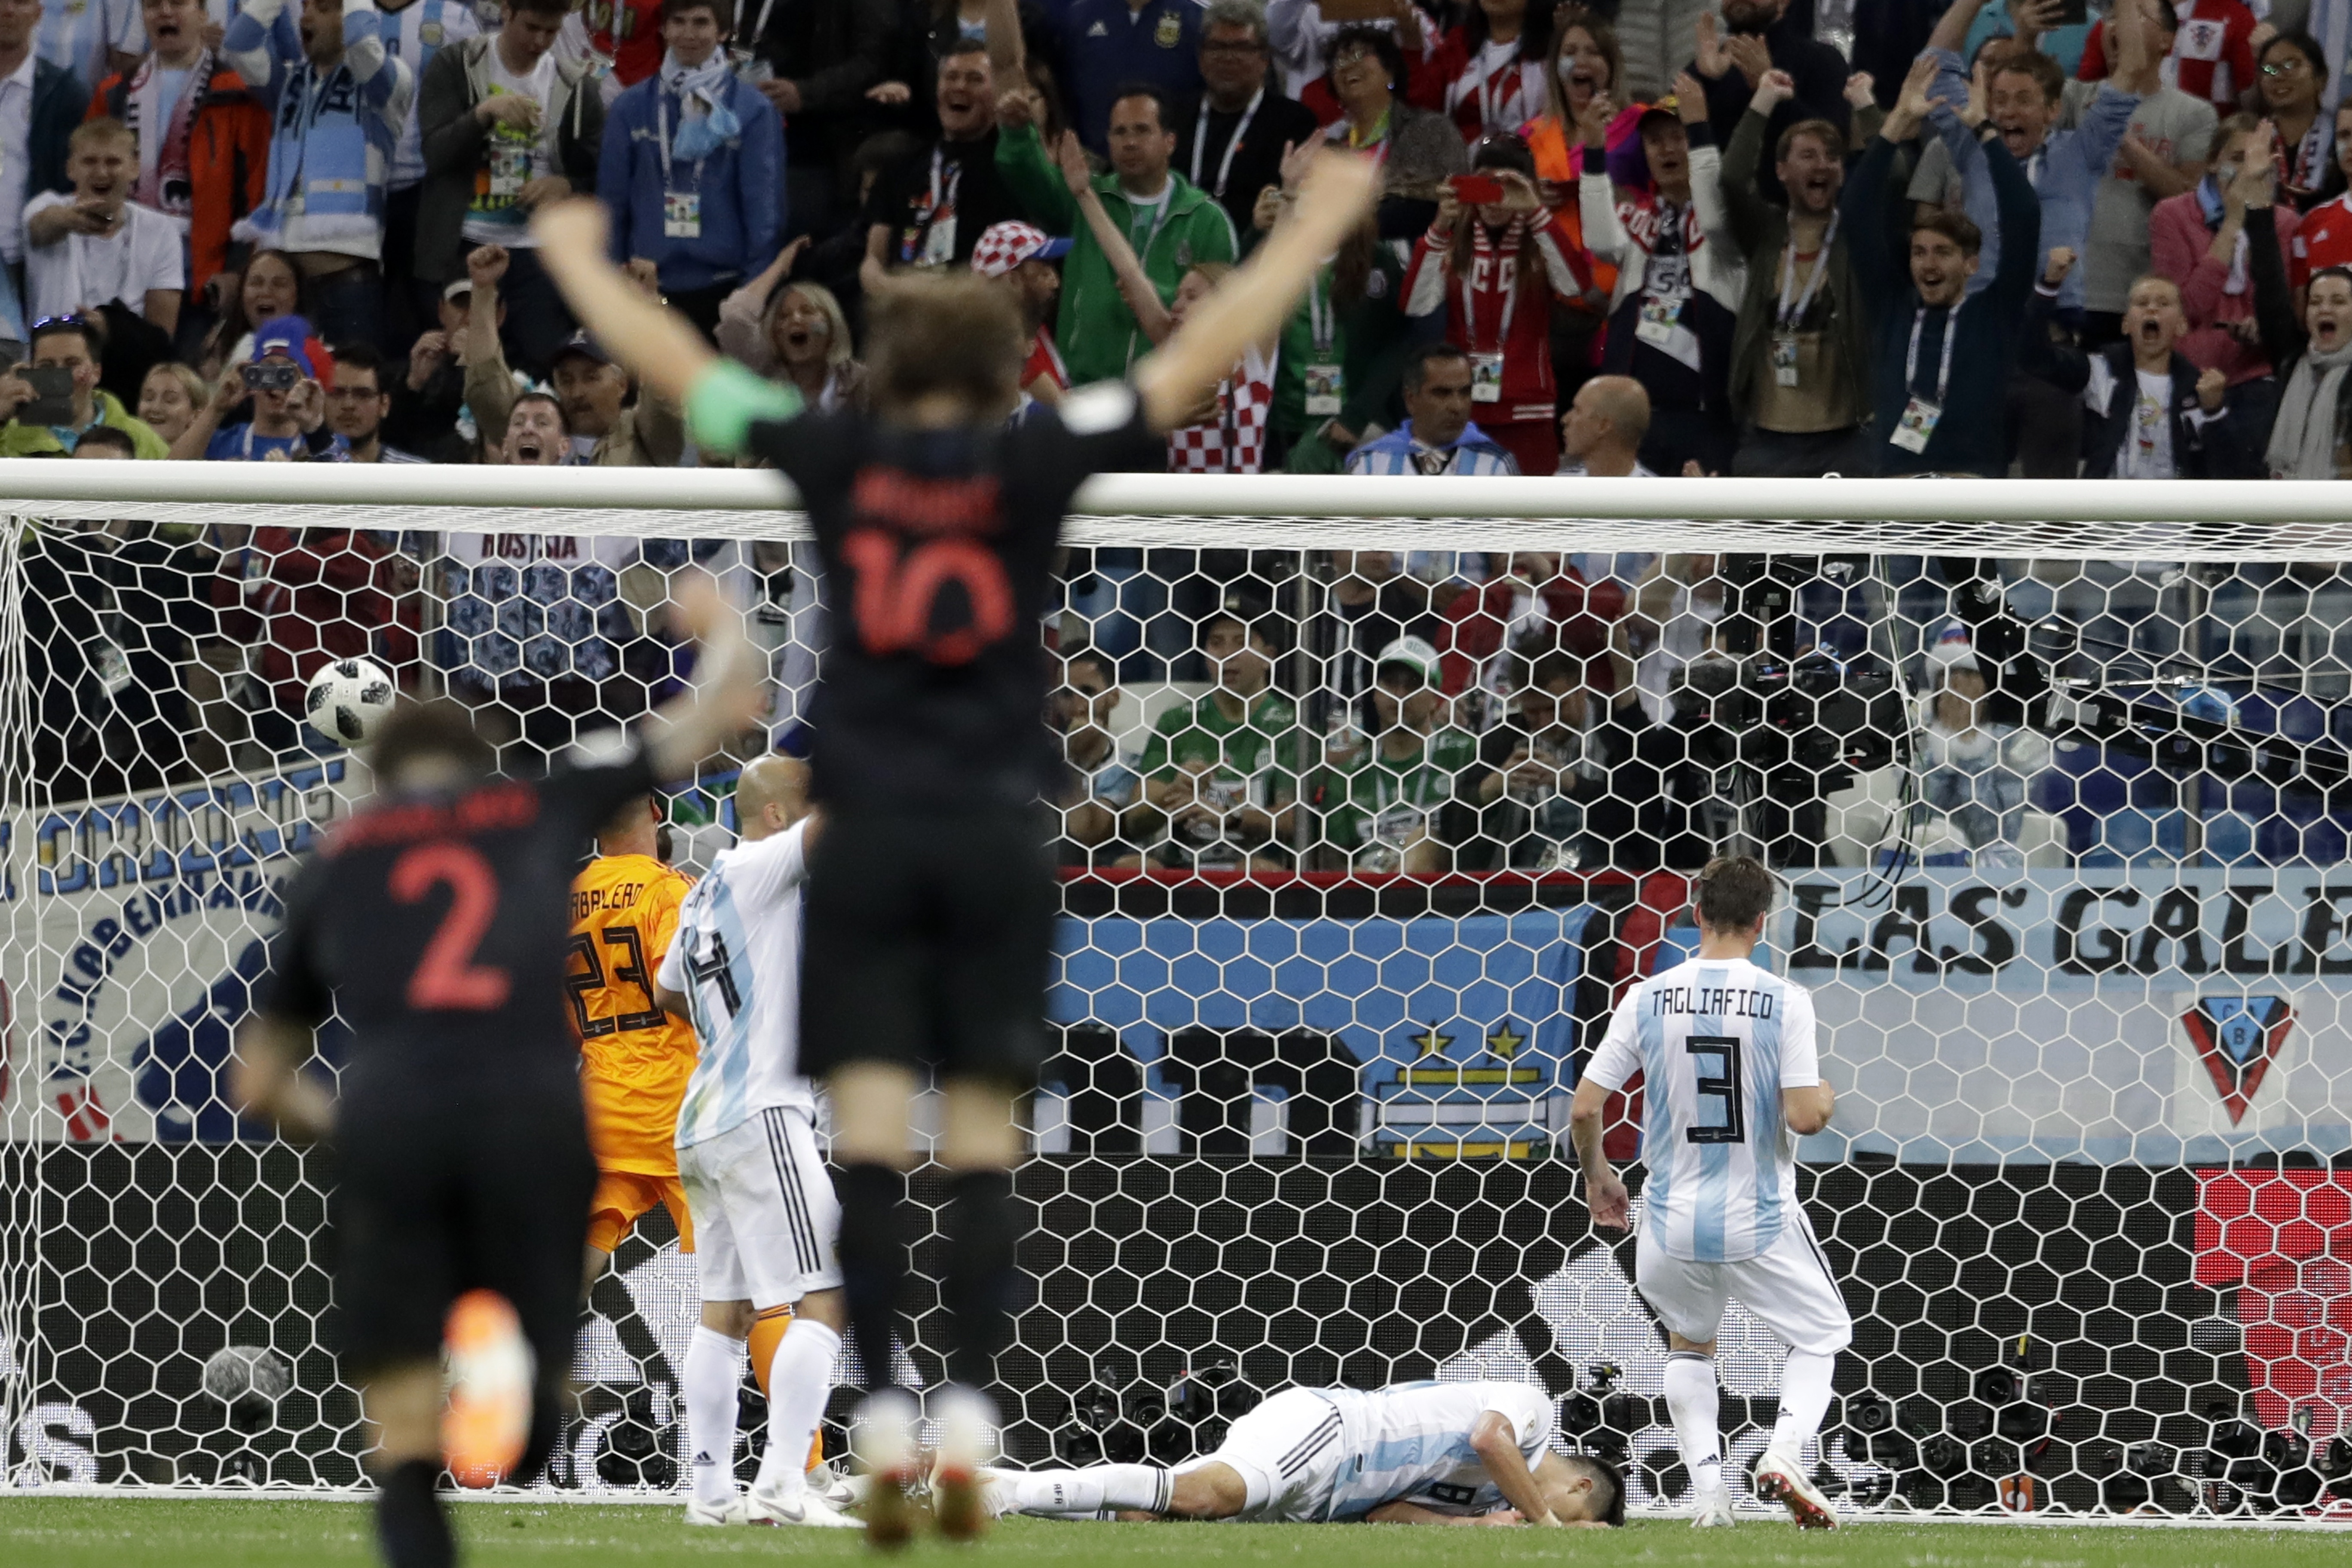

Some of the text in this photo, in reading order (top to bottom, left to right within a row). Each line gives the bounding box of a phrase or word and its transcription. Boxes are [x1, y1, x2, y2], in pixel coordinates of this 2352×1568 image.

[840, 528, 1015, 665] 10
[387, 843, 512, 1012] 2
[564, 925, 668, 1039] 23
[1789, 885, 2028, 974] LAS
[1652, 988, 1773, 1020] TAGLIAFICO
[1686, 1036, 1745, 1144] 3
